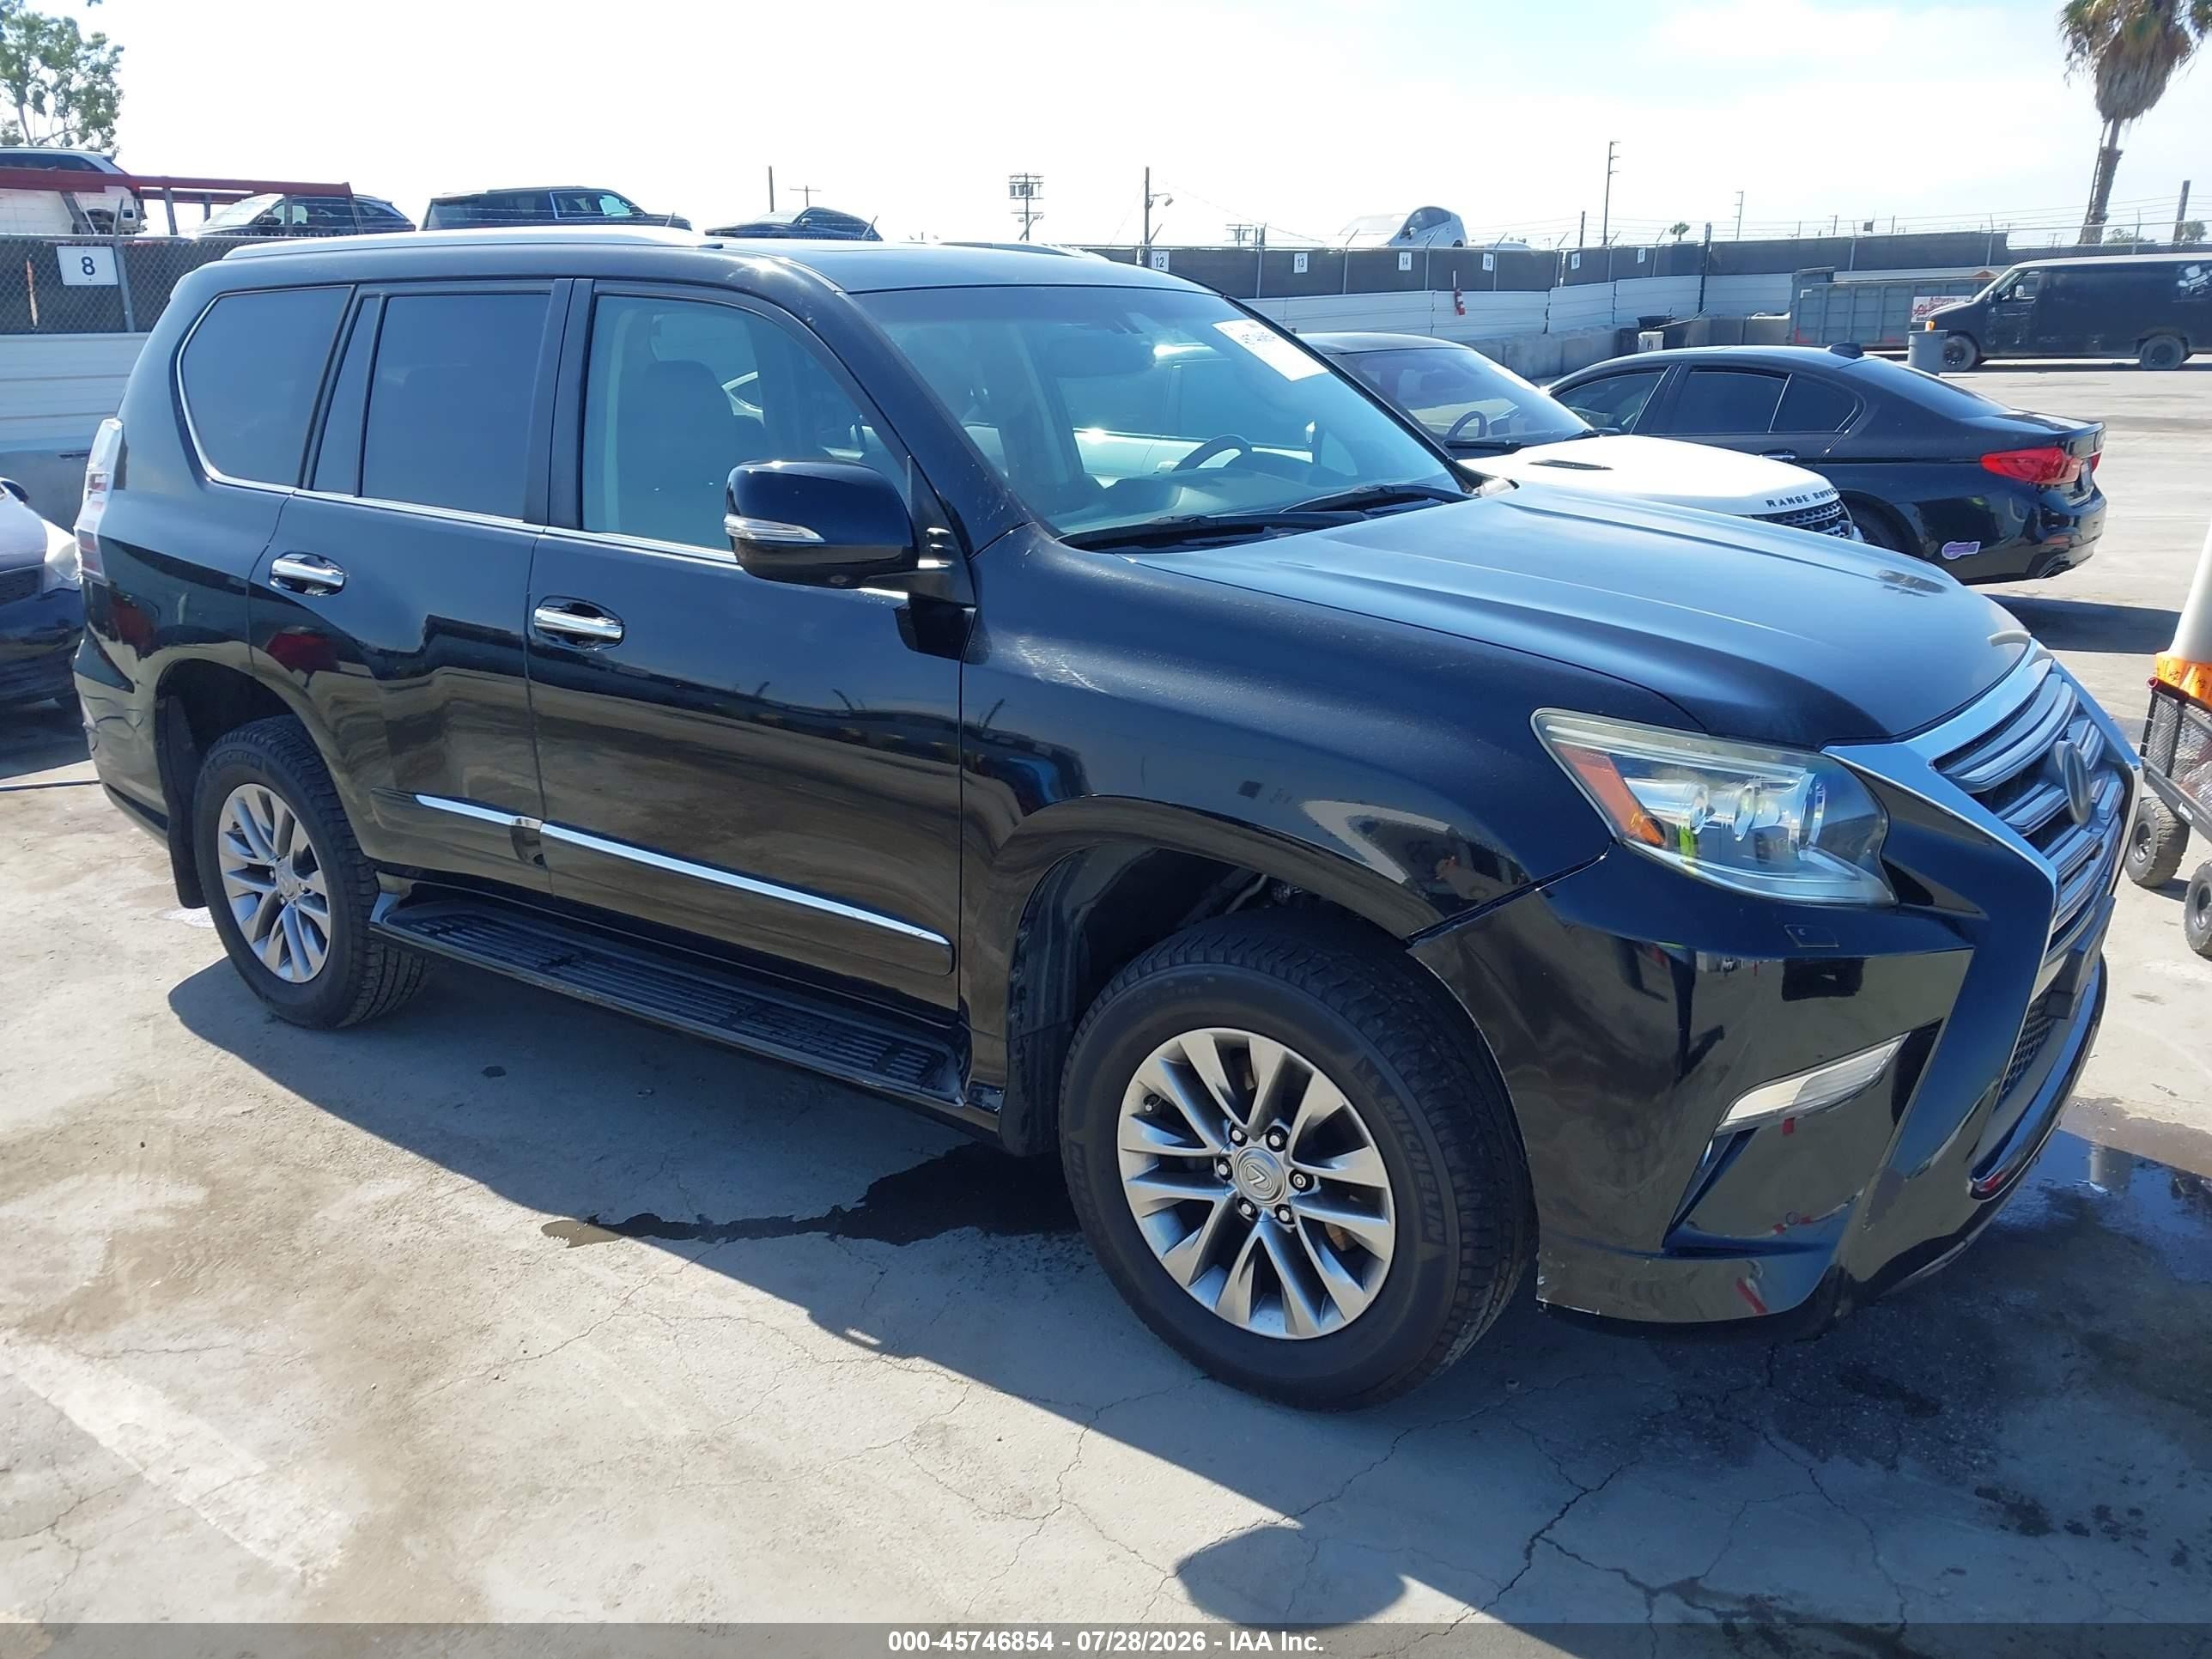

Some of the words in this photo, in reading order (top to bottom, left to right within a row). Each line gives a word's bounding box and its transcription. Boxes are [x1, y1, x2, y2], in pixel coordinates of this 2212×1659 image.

[81, 256, 95, 276] 8
[1156, 257, 1164, 268] 12
[1297, 257, 1304, 268] 13
[1765, 494, 1810, 507] RANGE
